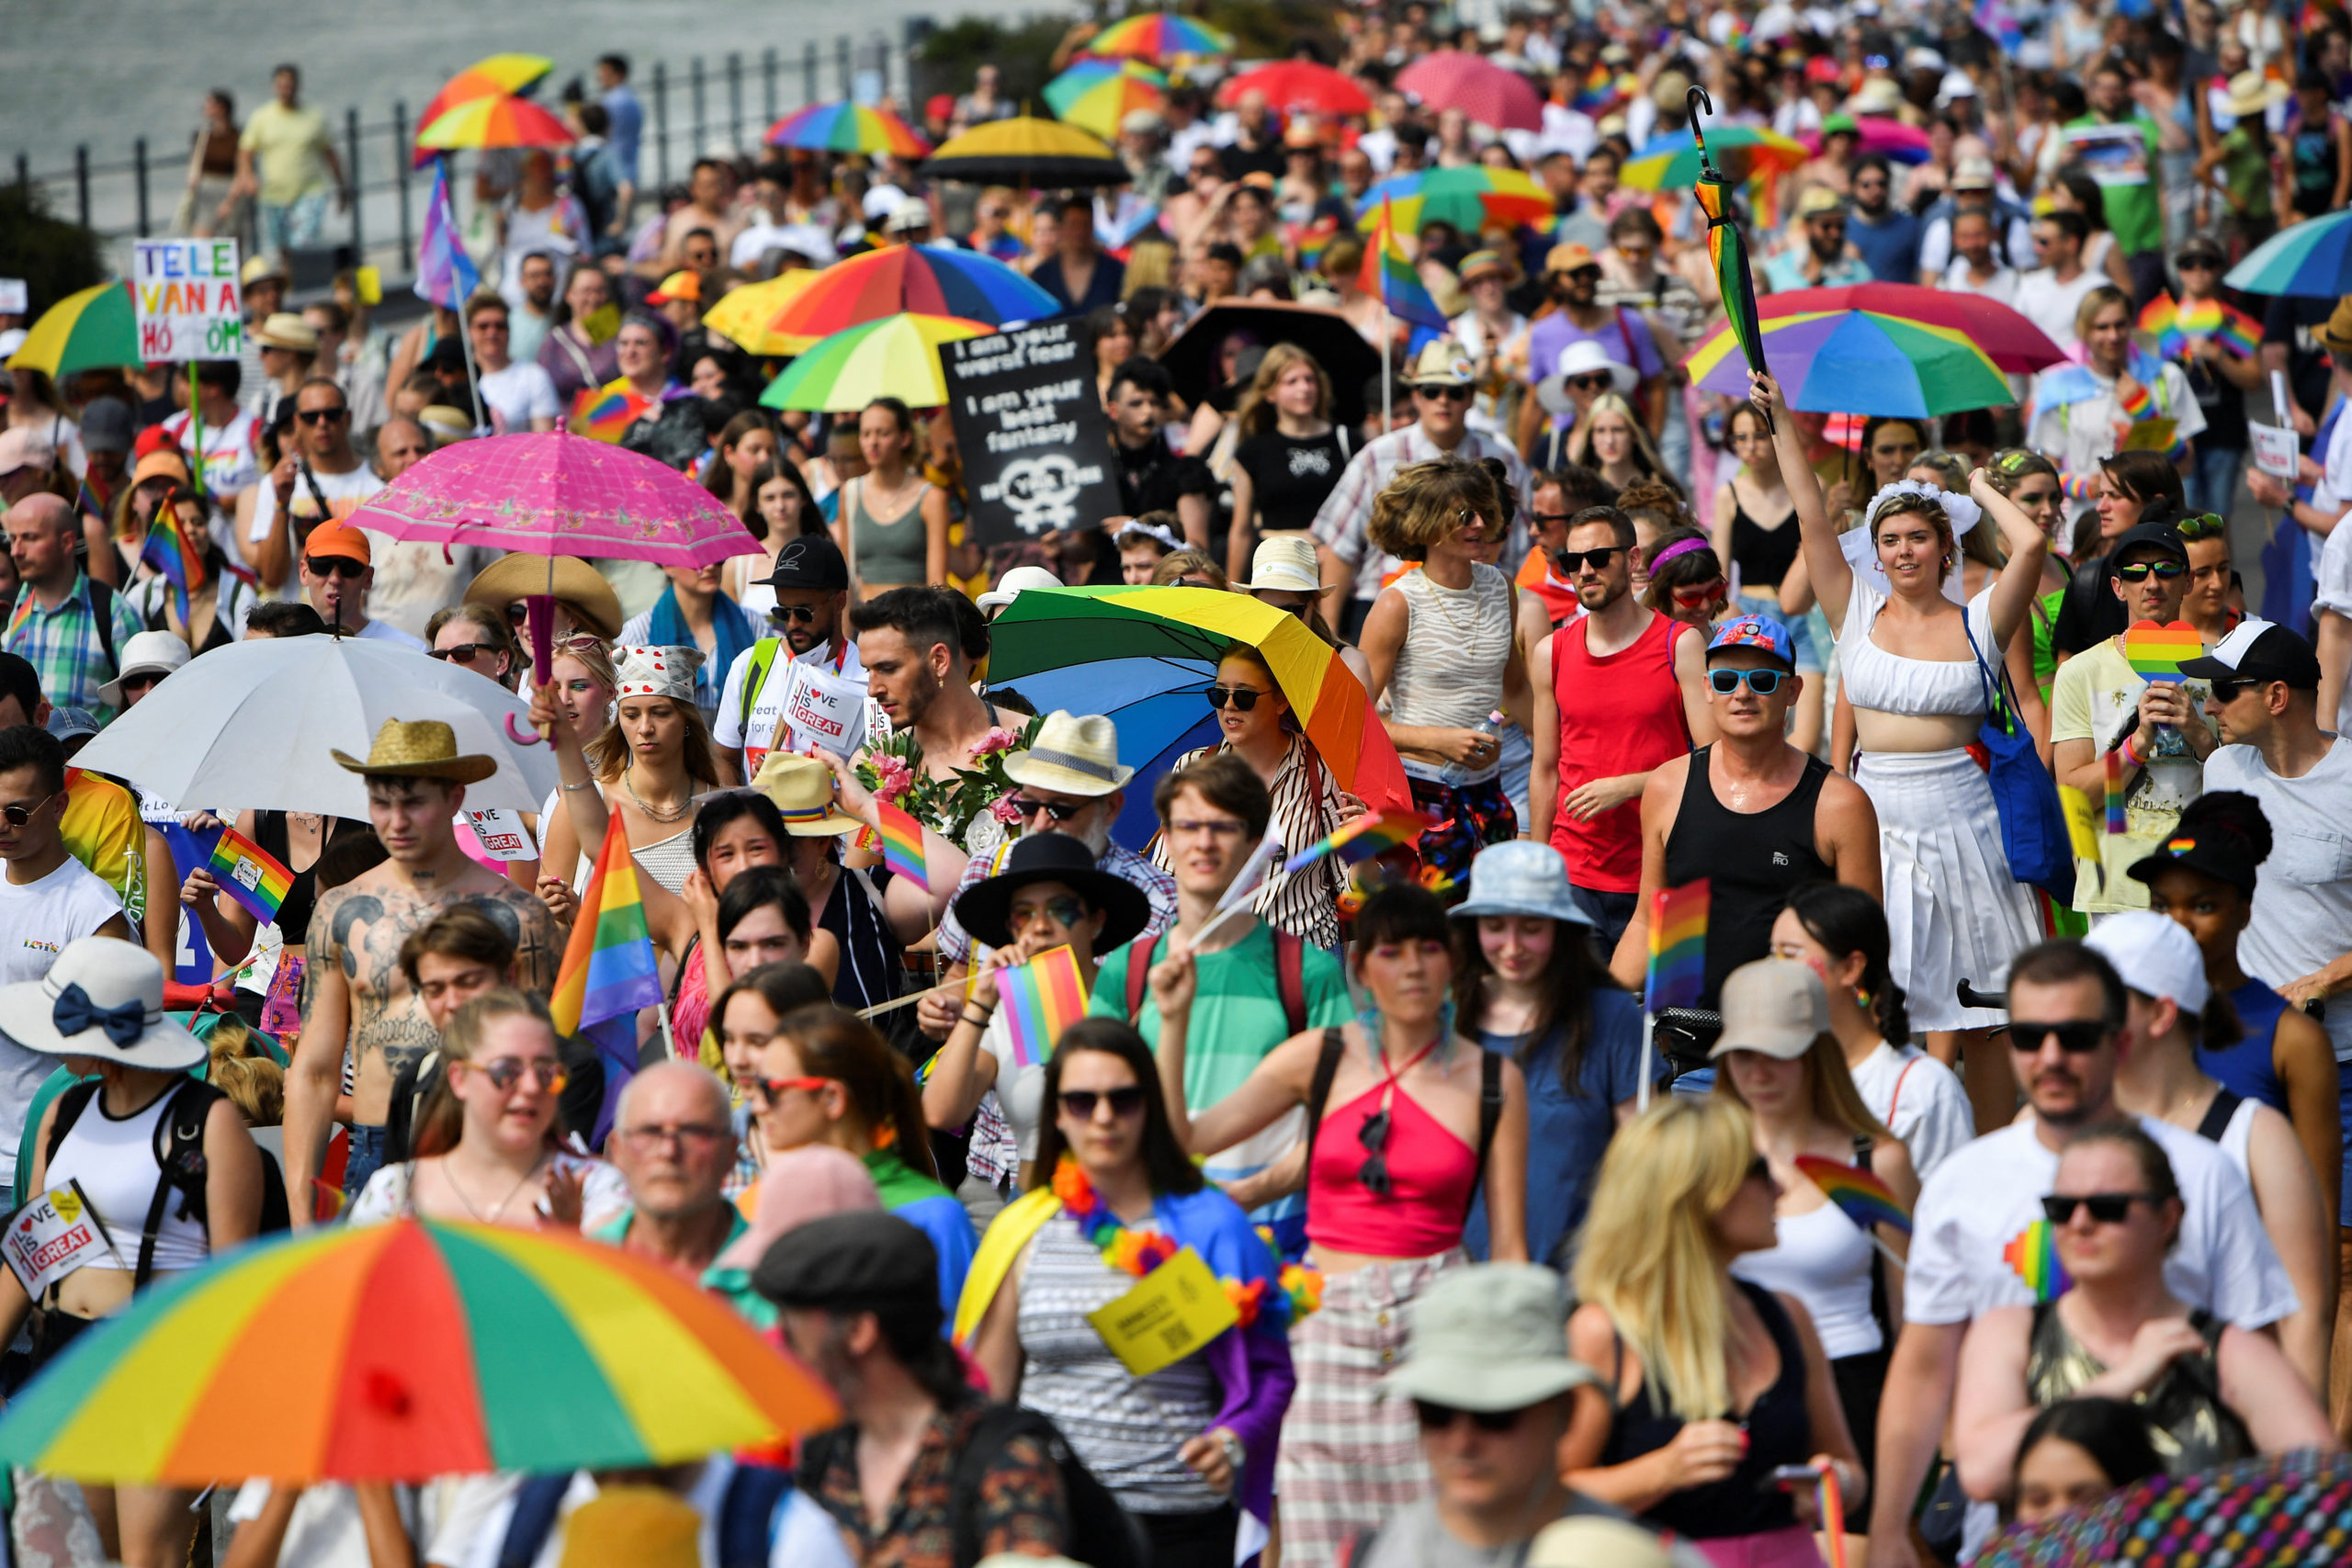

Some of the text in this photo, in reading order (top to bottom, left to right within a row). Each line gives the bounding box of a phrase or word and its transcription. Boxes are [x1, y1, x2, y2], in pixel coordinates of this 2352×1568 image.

[137, 243, 233, 277] TELE
[140, 283, 238, 315] VAN A
[954, 323, 1069, 359] I am your
[954, 341, 1078, 379] worst fear
[966, 378, 1082, 417] I am your
[1000, 403, 1057, 431] best
[986, 420, 1078, 453] fantasy
[799, 694, 811, 708] IS
[752, 720, 766, 733] for
[797, 708, 842, 737] GREAT
[153, 800, 169, 810] Lo
[485, 835, 522, 850] GREAT
[1773, 856, 1789, 866] PRO
[34, 1229, 89, 1268] GREAT
